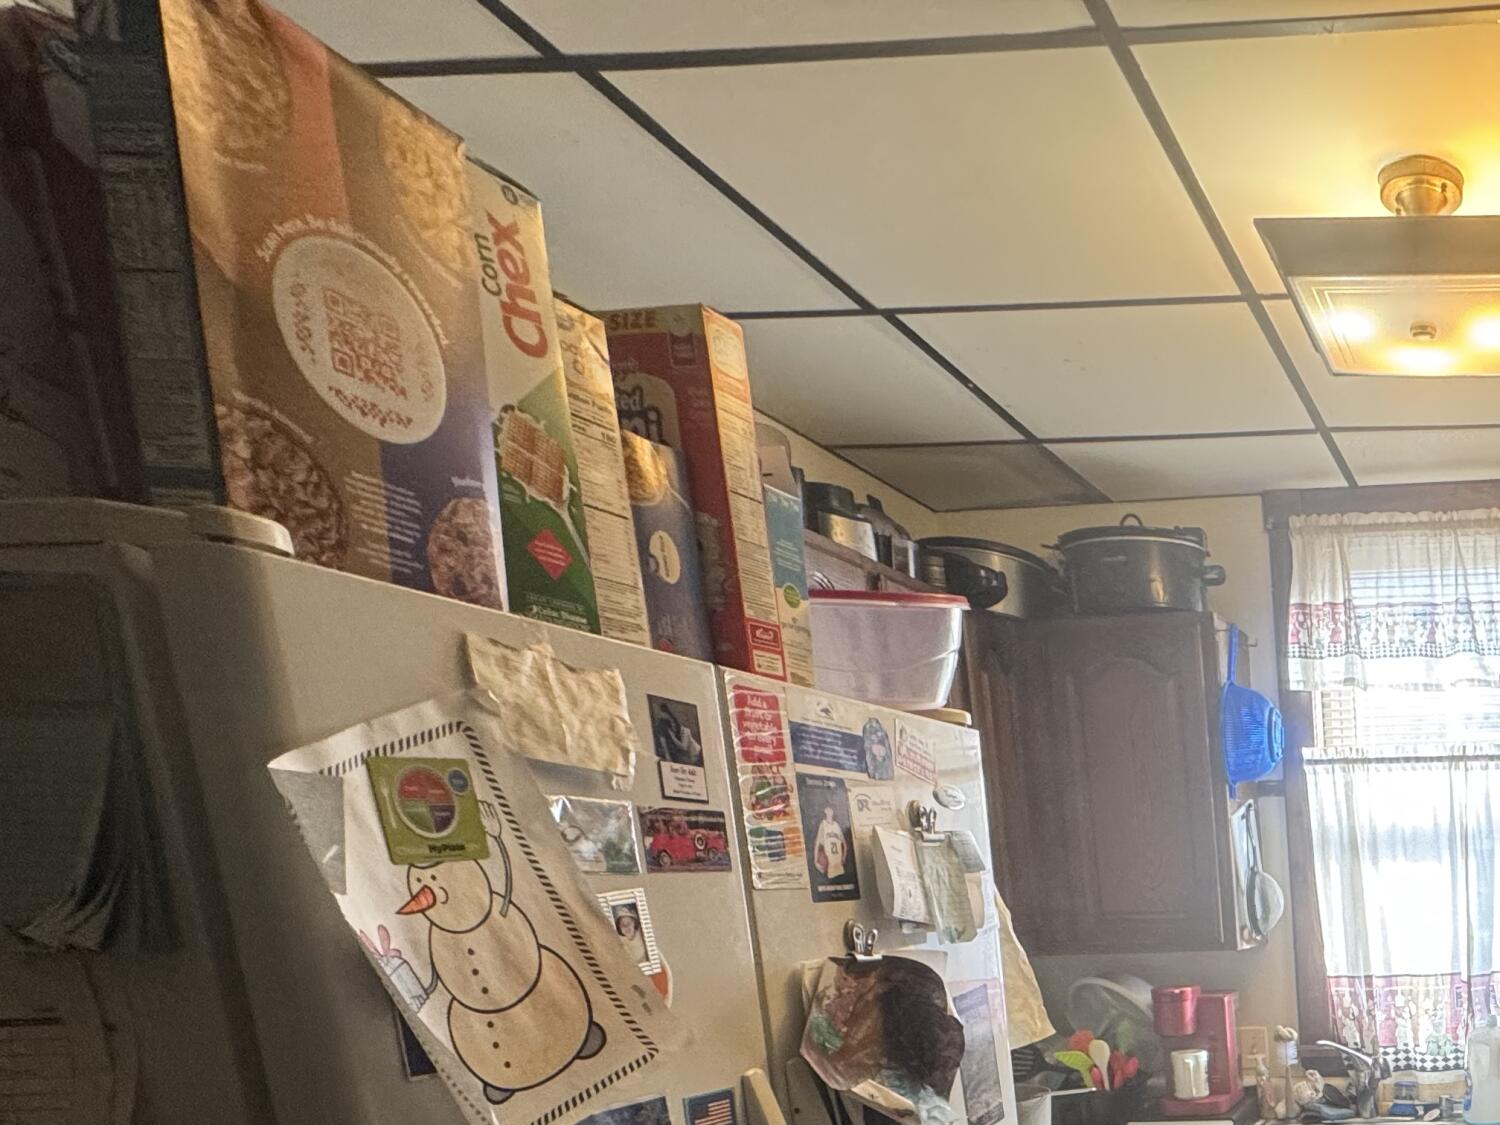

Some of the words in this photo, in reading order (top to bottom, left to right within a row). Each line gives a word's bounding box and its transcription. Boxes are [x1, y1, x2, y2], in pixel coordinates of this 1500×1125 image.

[474, 232, 503, 297] Corn
[486, 209, 549, 359] Chex
[609, 309, 657, 331] SIZE
